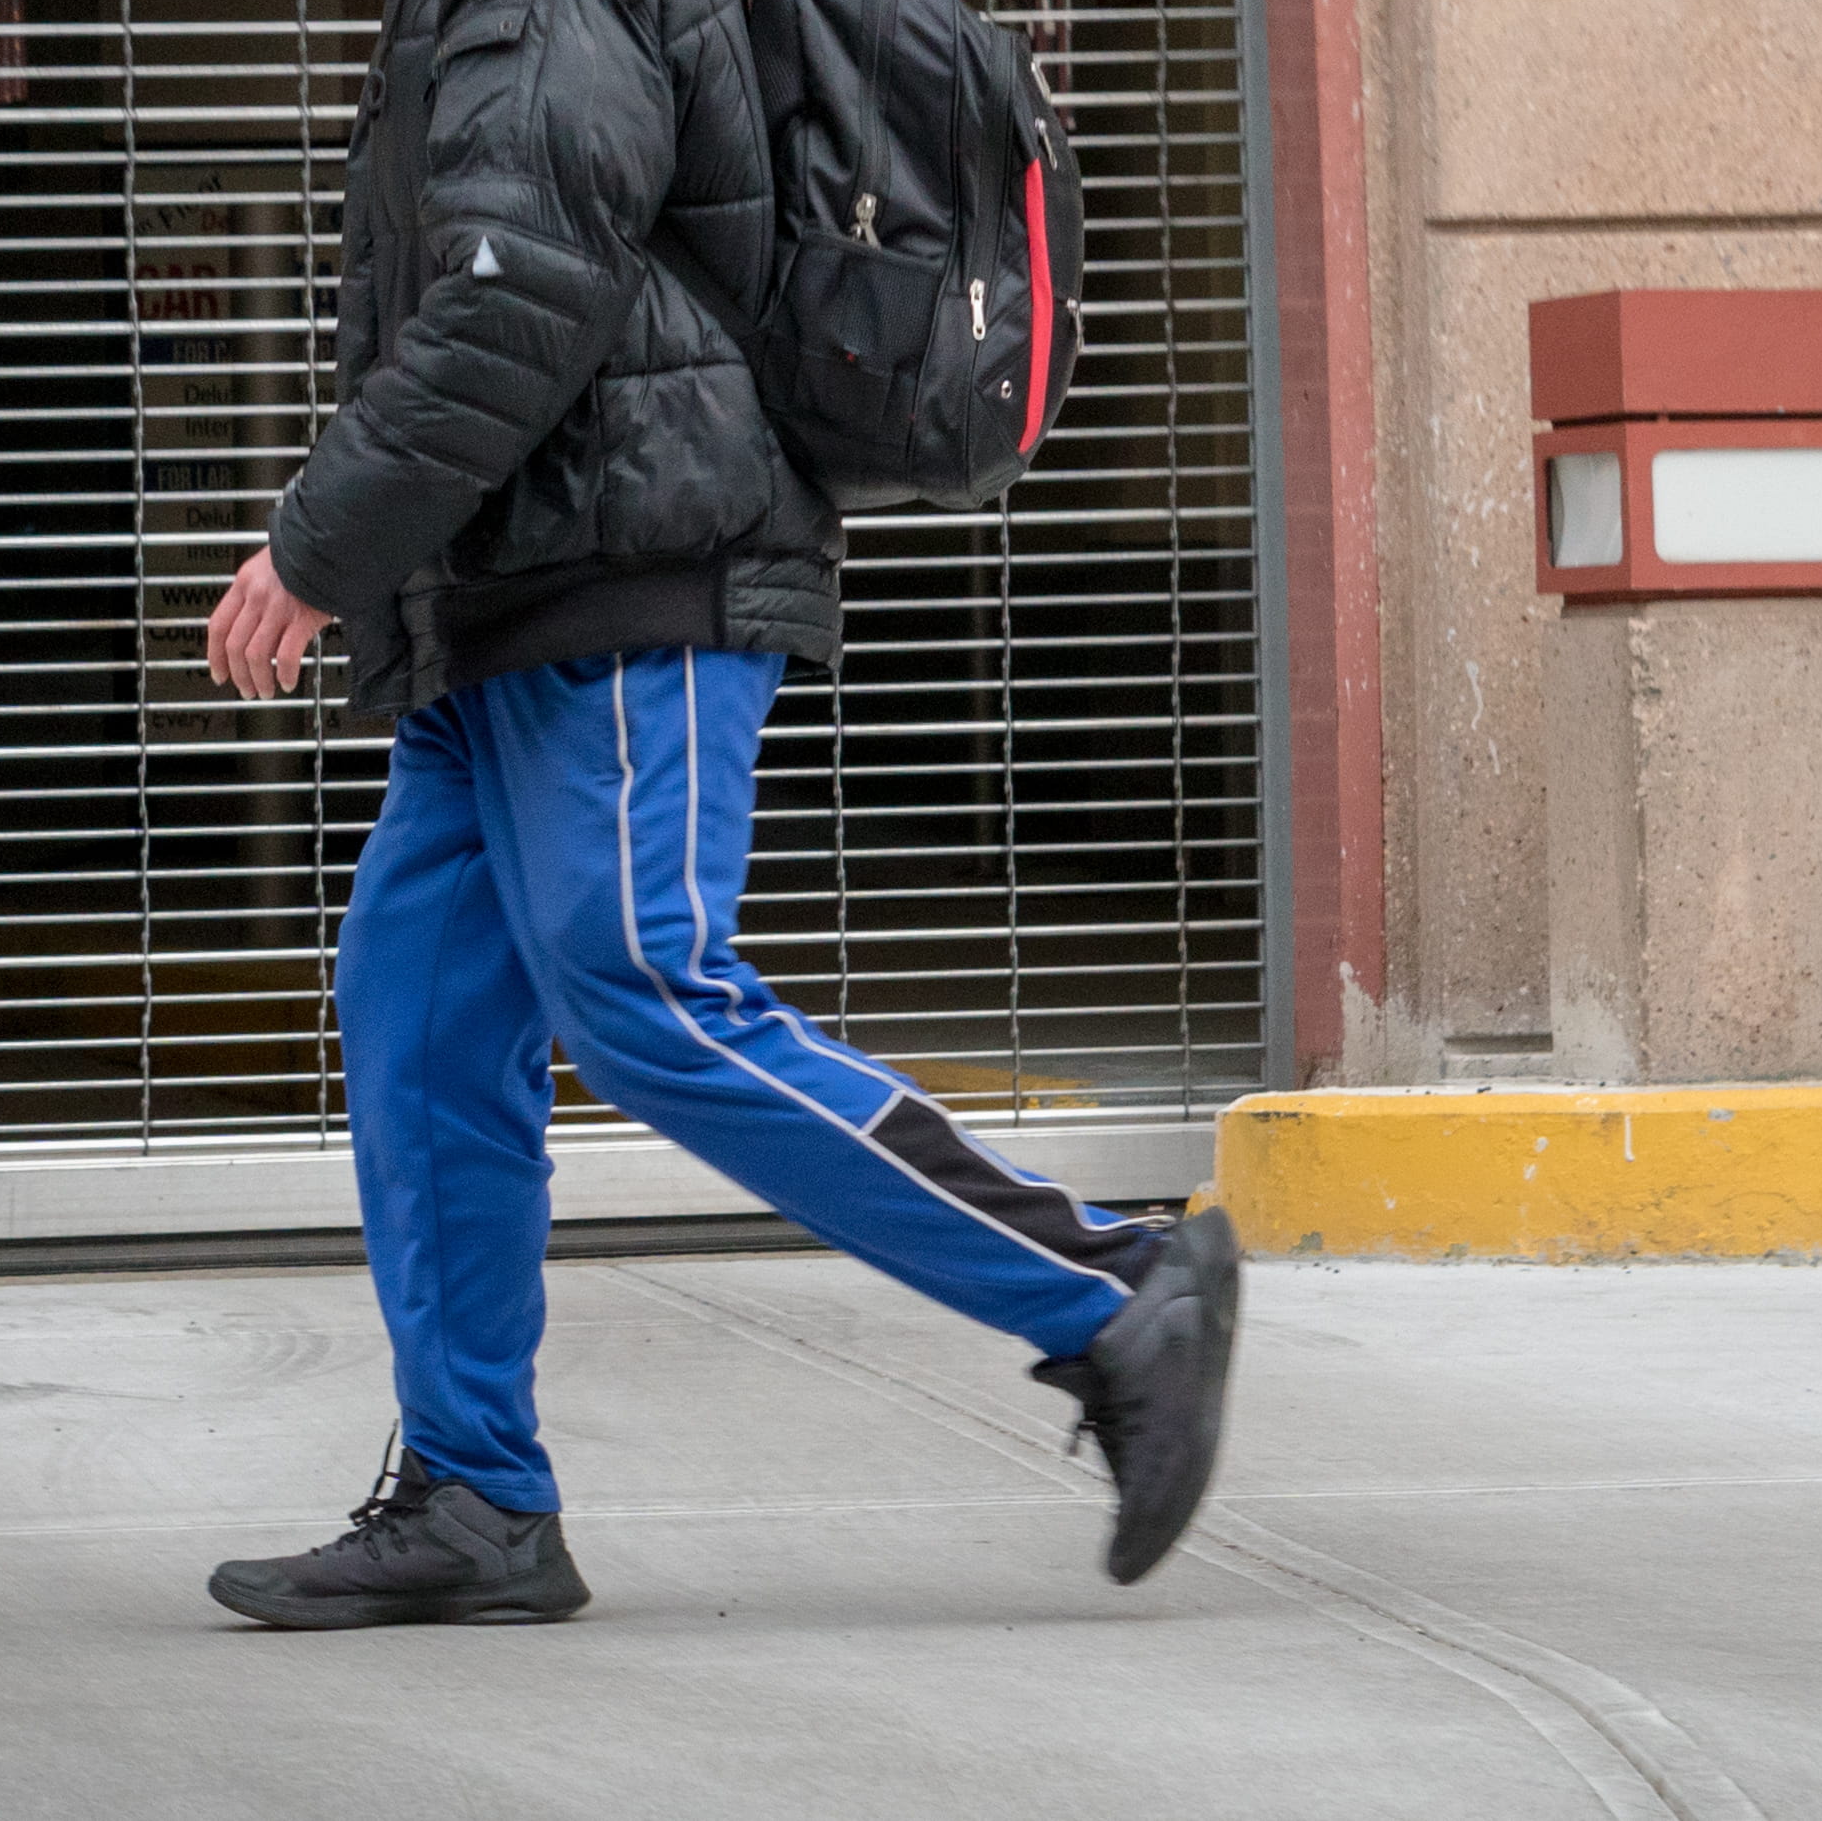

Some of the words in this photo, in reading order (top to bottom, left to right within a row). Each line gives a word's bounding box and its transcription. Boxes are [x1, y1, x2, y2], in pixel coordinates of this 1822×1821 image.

[184, 383, 232, 404] Delu
[185, 416, 229, 438] Inter
[196, 461, 231, 490] LAR
[187, 506, 230, 528] Delu
